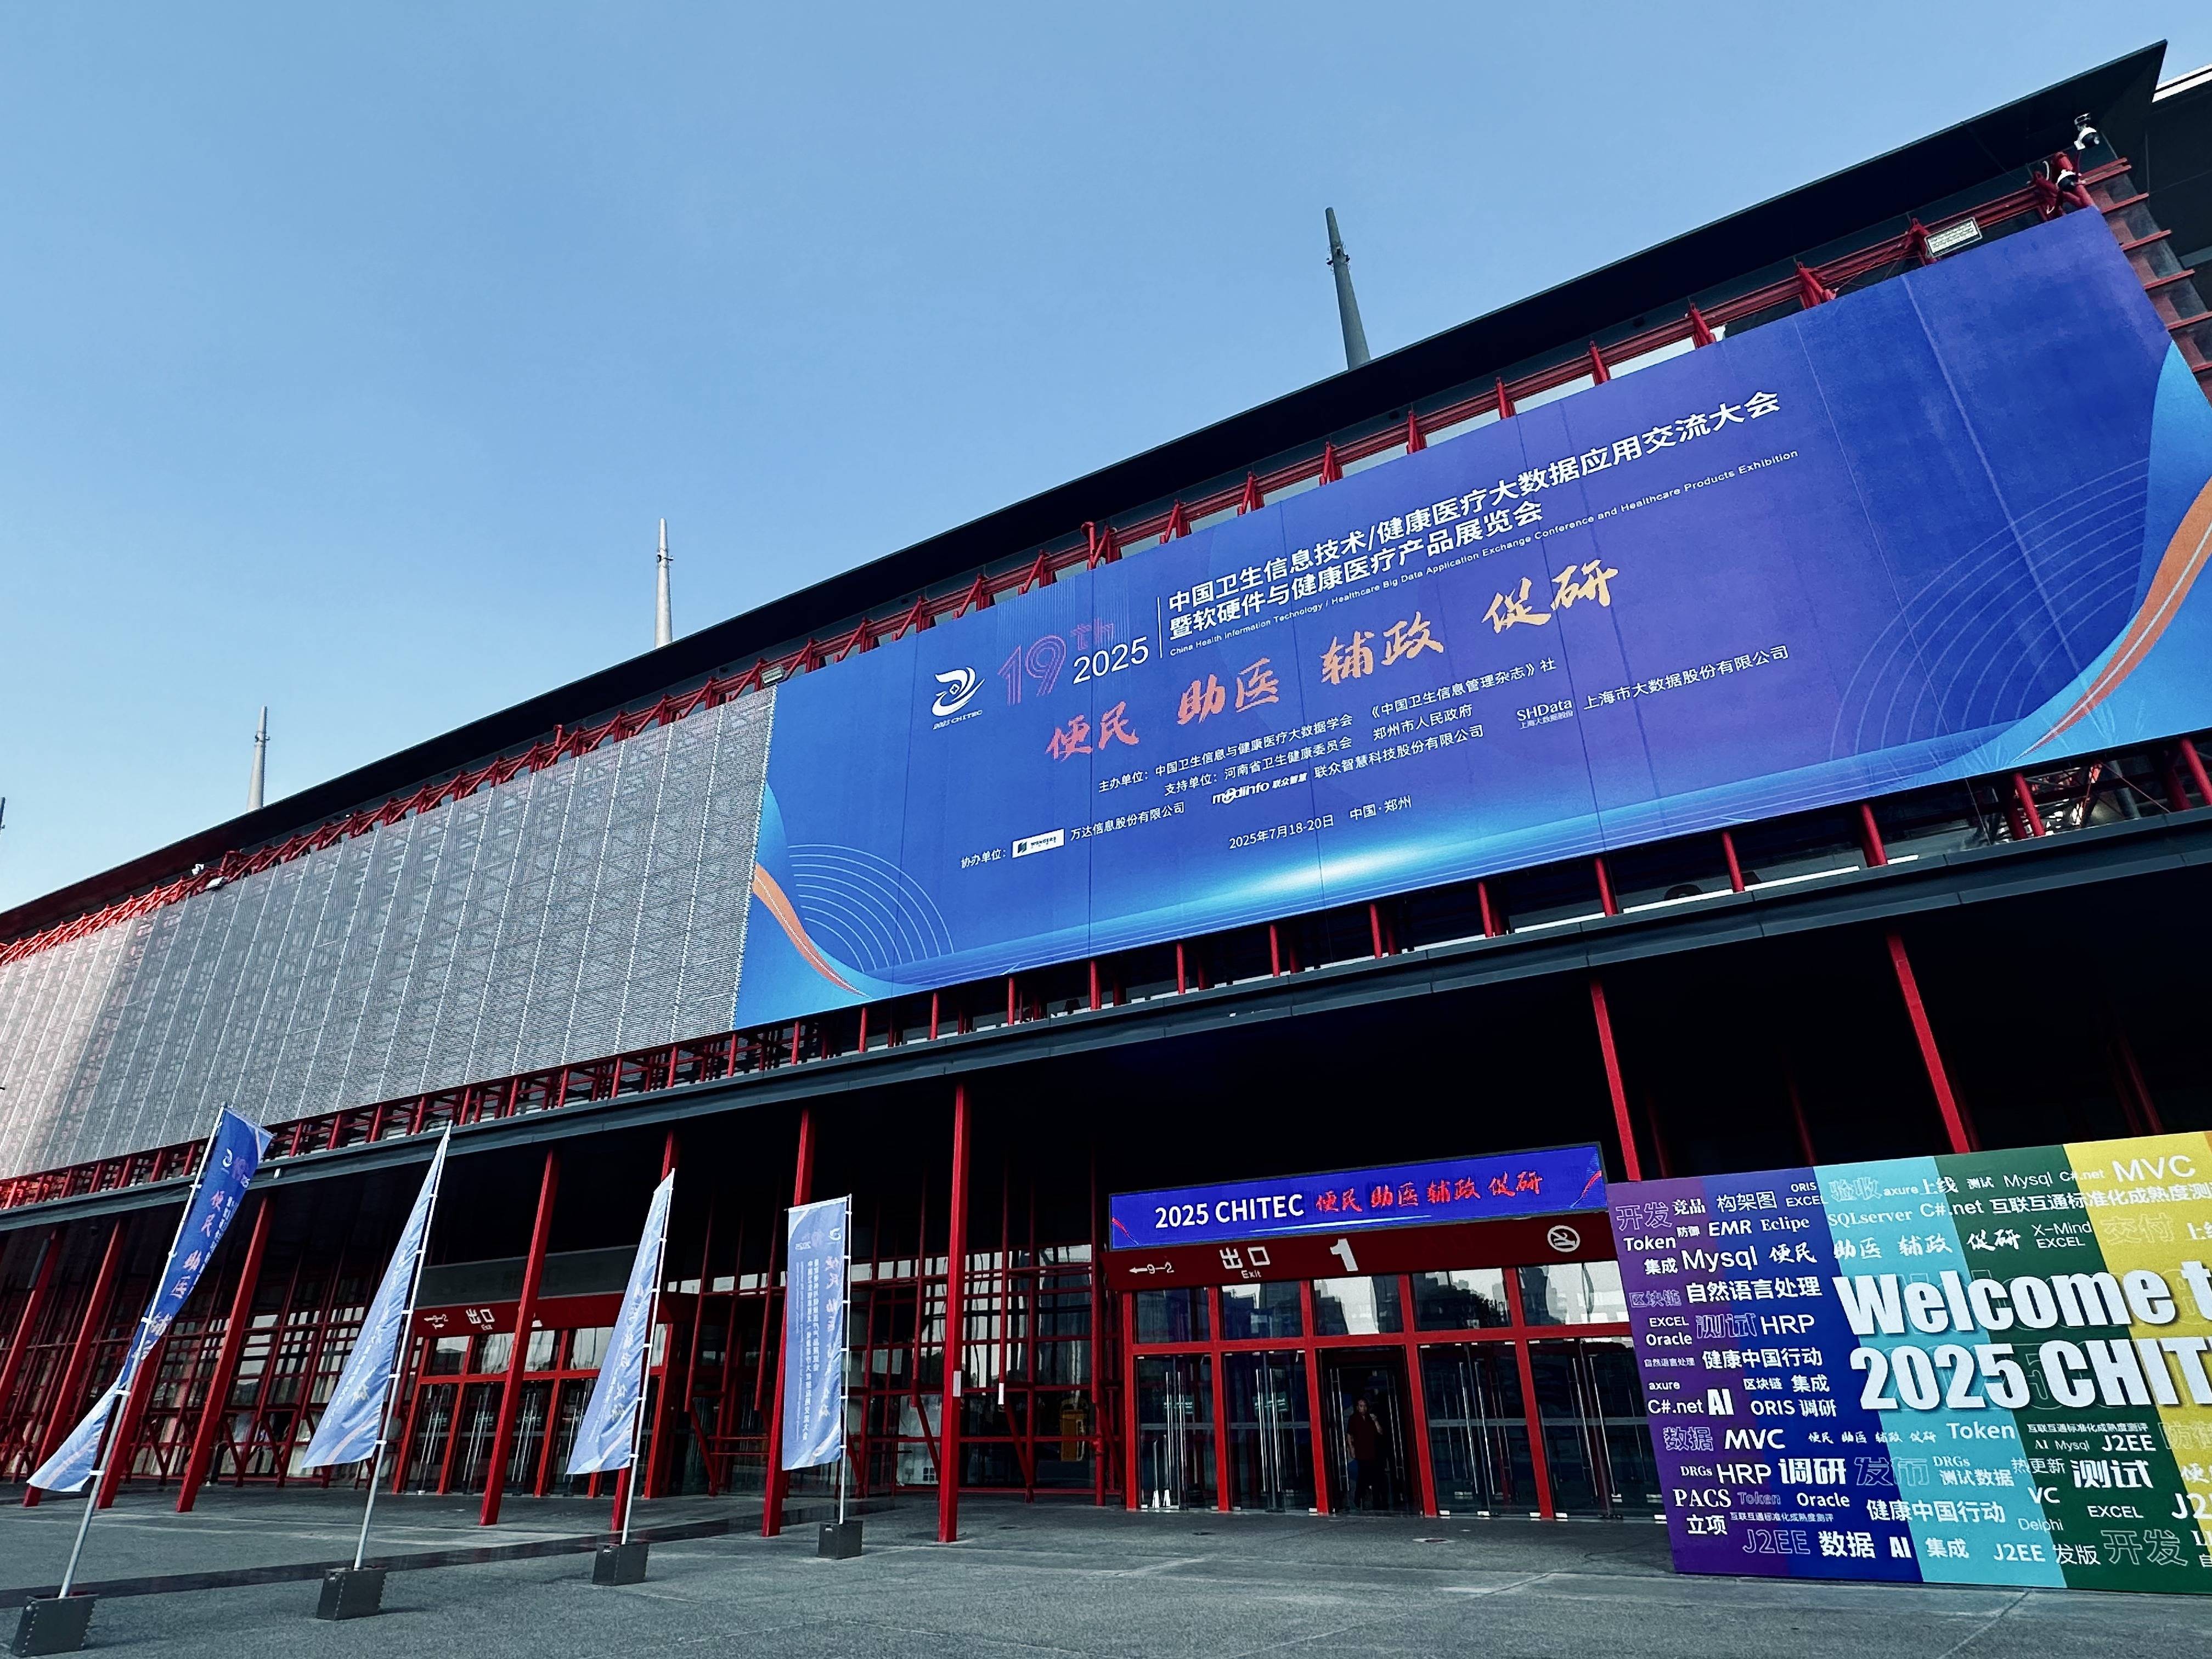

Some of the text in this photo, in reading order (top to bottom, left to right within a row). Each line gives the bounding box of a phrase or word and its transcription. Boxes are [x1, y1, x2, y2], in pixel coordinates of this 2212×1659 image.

[1169, 390, 1781, 613] 中国卫生信息技术/健康医疗大数据应用交流大会
[1170, 642, 1193, 657] China
[1195, 635, 1222, 650] Health
[1224, 618, 1271, 640] Information
[1273, 602, 1324, 625] Technology
[1331, 583, 1381, 605] Healthcare
[1382, 577, 1398, 589] Big
[1400, 569, 1424, 582] Data
[1425, 552, 1480, 575] Application
[1482, 534, 1532, 558] Exchange
[1534, 515, 1594, 540] Conference
[1597, 506, 1617, 520] and
[1620, 487, 1681, 512] Healthcare
[1683, 469, 1735, 492] Products
[1737, 449, 1798, 475] Exhibition
[1170, 499, 1543, 640] 暨软硬件与健康医疗产品展览会
[1045, 558, 1619, 761] 便民 助医 辅政 促研
[1073, 636, 1150, 685] 2025
[1583, 645, 1789, 710] 上海市大数据股份有限公司
[1516, 699, 1573, 722] SHData
[1155, 713, 1353, 778] 中国卫生信息与健康医疗大数据学会
[1224, 736, 1352, 781] 河南省卫生健康委员会
[1372, 703, 1474, 741] 郑州市人民政府
[1314, 724, 1485, 779] 联众智慧科技股份有限公司
[1272, 772, 1308, 789] 联众智慧
[1070, 802, 1186, 842] 万达信息股份有限公司
[1229, 814, 1334, 849] 2025年7月18-20日
[2059, 1169, 2106, 1182] C#.net
[2112, 1155, 2196, 1183] MVC
[1791, 1181, 1817, 1193] ORIS
[1828, 1176, 1882, 1203] 验收
[1920, 1176, 1959, 1195] 上线
[1967, 1176, 1995, 1190] 测试
[2004, 1171, 2053, 1189] Mysql
[1155, 1170, 1545, 1229] 2025 CHITEC 便民 助医 辅政 促研
[1786, 1194, 1827, 1208] EXCEL
[1883, 1185, 1918, 1197] axure
[1989, 1181, 2212, 1215] 互联互通标准化成熟度测
[1672, 1198, 1706, 1216] 竞品
[1716, 1190, 1778, 1213] 构架图
[1920, 1200, 1984, 1218] C#.net
[1616, 1201, 1673, 1231] 开发
[1760, 1217, 1810, 1233] Eclipe
[1827, 1209, 1913, 1228] SQLserver
[1708, 1219, 1752, 1237] EMR
[2031, 1221, 2092, 1237] X-Mind
[1623, 1235, 1677, 1252] Token
[1768, 1228, 2022, 1265] 便民 助医 辅政 促研
[2036, 1236, 2086, 1249] EXCEL
[1219, 1246, 1271, 1269] 出口
[1329, 1238, 1359, 1272] 1
[1681, 1246, 1758, 1273] Mysql
[1241, 1269, 1262, 1279] Exit
[1644, 1257, 1678, 1276] 集成
[1628, 1289, 1683, 1308] 区块链
[1685, 1276, 1823, 1304] 自然语言处理
[1832, 1269, 2177, 1335] Welcome
[465, 1308, 495, 1324] 出口
[1649, 1316, 1690, 1328] EXCEL
[1695, 1312, 1757, 1339] 测试
[1761, 1314, 1815, 1335] HRP
[1646, 1331, 1693, 1346] Oracle
[1702, 1347, 1823, 1370] 健康中国行动
[1850, 1336, 2212, 1410] 2025 CHIT
[1648, 1380, 1681, 1391] axure
[1743, 1378, 1784, 1391] 区块链
[1791, 1374, 1830, 1393] 集成
[1648, 1399, 1704, 1415] C#.net
[1707, 1388, 1735, 1416] AI
[1750, 1400, 1796, 1415] ORIS
[1798, 1398, 1837, 1418] 调研
[1663, 1426, 1714, 1452] 数据
[1724, 1429, 1786, 1449] MVC
[1946, 1421, 2016, 1440] Token
[2035, 1440, 2049, 1450] AI
[2055, 1440, 2090, 1452] Mysql
[2101, 1434, 2157, 1452] J2EE
[1680, 1465, 1712, 1478] DRGs
[1778, 1457, 1847, 1486] 调研
[1933, 1455, 1971, 1468] DRGs
[2011, 1457, 2066, 1475] 热更新
[1717, 1464, 1771, 1484] HRP
[1853, 1457, 1931, 1487] 发布
[1939, 1469, 2015, 1487] 测试数据
[2070, 1459, 2154, 1489] 测试
[2180, 1462, 2212, 1483] 便
[1673, 1488, 1733, 1508] PACS
[1737, 1491, 1781, 1505] Token
[1797, 1492, 1850, 1509] Oracle
[2027, 1487, 2061, 1504] VC
[1866, 1499, 2006, 1524] 健康中国行动
[2087, 1505, 2145, 1519] EXCEL
[2171, 1492, 2212, 1520] J2
[1686, 1514, 1728, 1536] 立项
[2017, 1517, 2064, 1533] Delphi
[1742, 1529, 1811, 1555] J2EE
[1818, 1531, 1876, 1559] 数据
[1890, 1536, 1912, 1559] AI
[1925, 1537, 1970, 1559] 集成
[2100, 1528, 2189, 1567] 开发
[1993, 1543, 2046, 1562] J2EE
[2052, 1544, 2101, 1566] 发版
